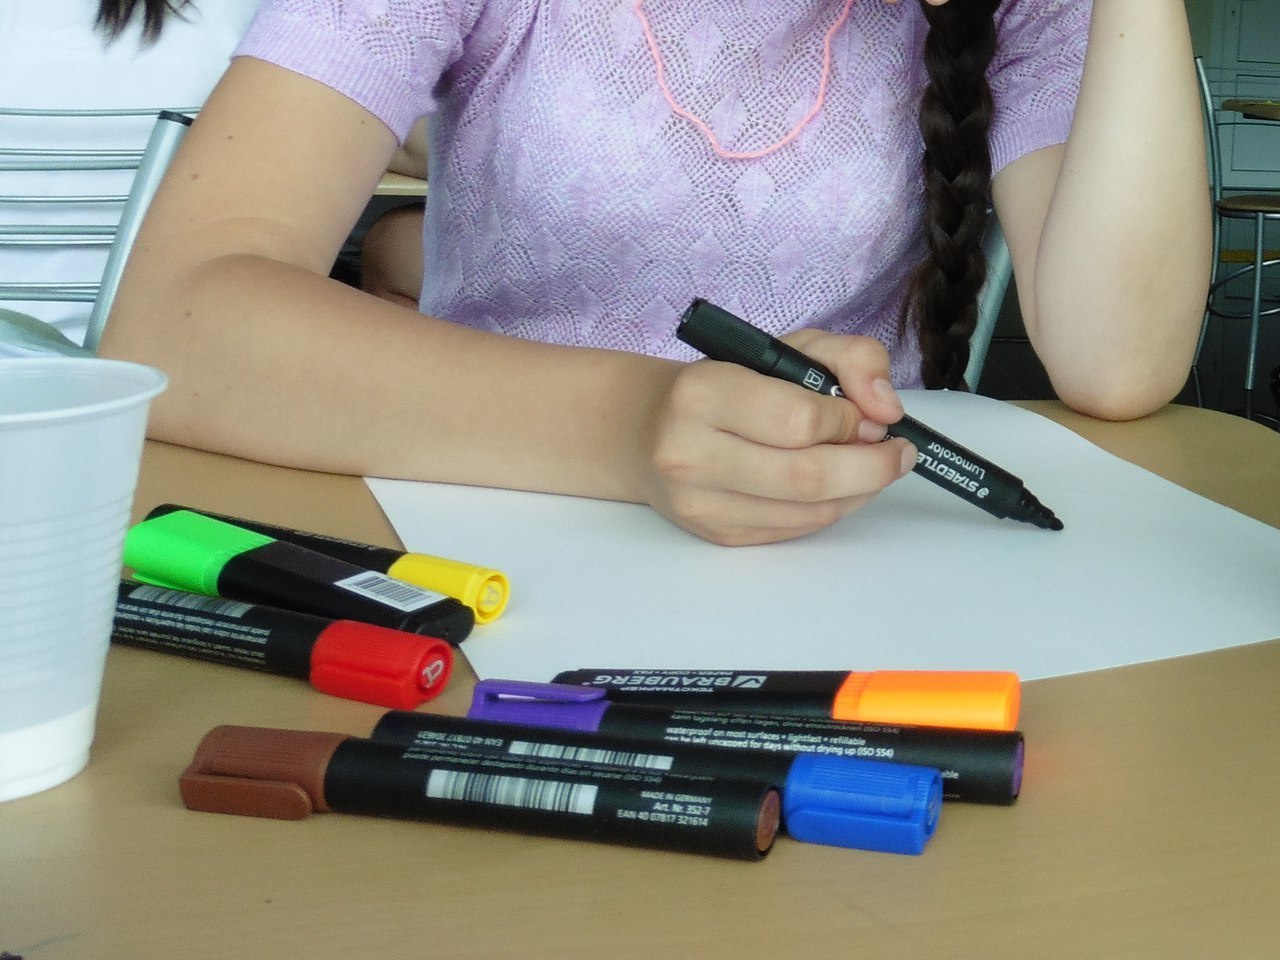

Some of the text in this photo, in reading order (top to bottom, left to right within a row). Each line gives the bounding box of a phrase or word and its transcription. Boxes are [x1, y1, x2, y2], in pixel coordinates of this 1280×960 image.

[927, 441, 986, 480] Lumocolor
[916, 451, 979, 494] STAEDTLE
[593, 675, 735, 687] BRAUBERG
[666, 727, 713, 737] waterproof
[726, 730, 746, 738] most
[747, 731, 780, 740] surfaces
[788, 733, 822, 743] lightfast
[830, 736, 866, 746] refillable
[749, 740, 762, 749] for
[763, 741, 782, 751] days
[783, 743, 816, 753] without
[817, 745, 843, 756] drying
[845, 747, 856, 756] up
[857, 746, 875, 756] (ISO
[875, 747, 894, 758] 554)
[640, 791, 665, 800] MADE
[674, 793, 713, 804] GERMANY
[653, 802, 669, 811] Art.
[617, 809, 637, 819] EAN
[638, 811, 649, 821] 40
